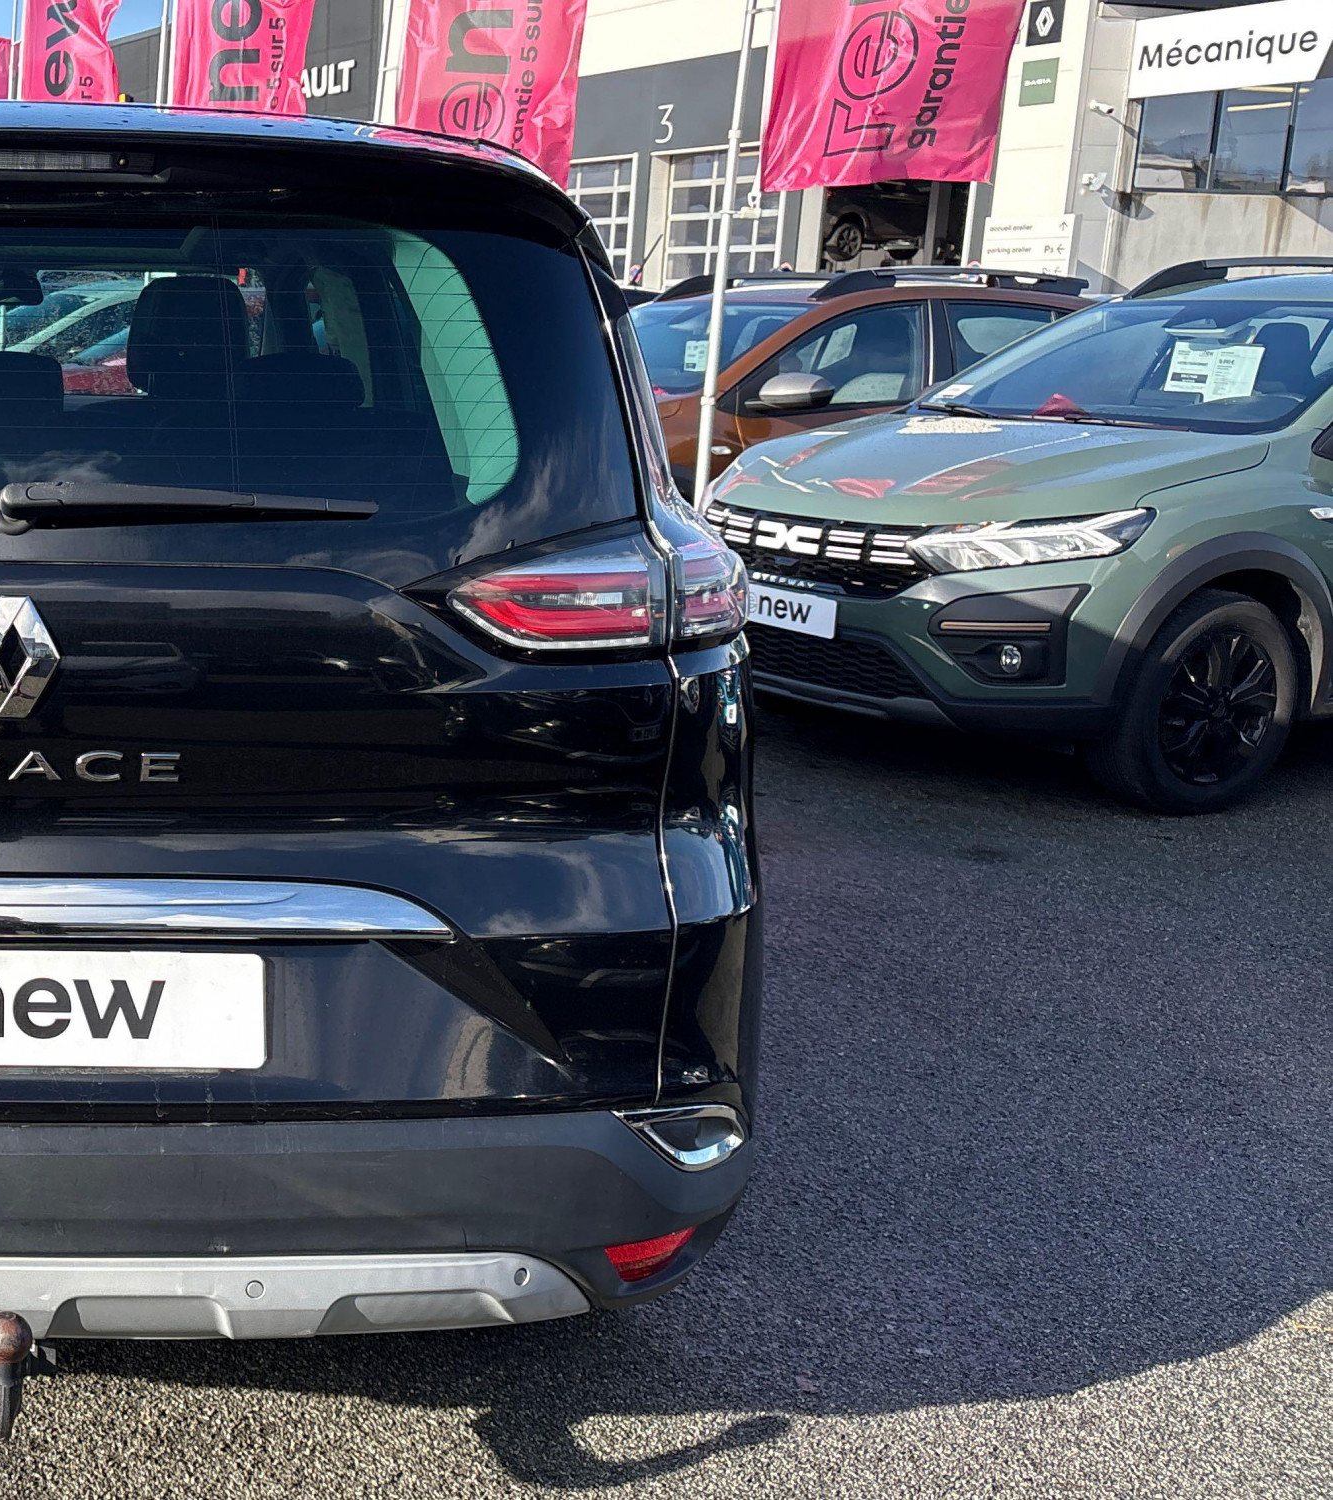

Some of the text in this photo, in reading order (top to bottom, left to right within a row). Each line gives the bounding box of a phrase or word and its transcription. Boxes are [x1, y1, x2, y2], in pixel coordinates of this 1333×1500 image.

[269, 17, 286, 31] 5
[270, 36, 285, 75] sur
[520, 46, 538, 62] 5
[1138, 30, 1318, 70] Mécanique
[79, 76, 94, 87] 5
[300, 59, 356, 99] AULT
[823, 0, 919, 157] re
[907, 0, 970, 150] garantie
[1024, 78, 1052, 87] DACIA
[655, 104, 674, 144] 3
[987, 247, 1011, 255] parking
[752, 571, 816, 589] STEPWAY
